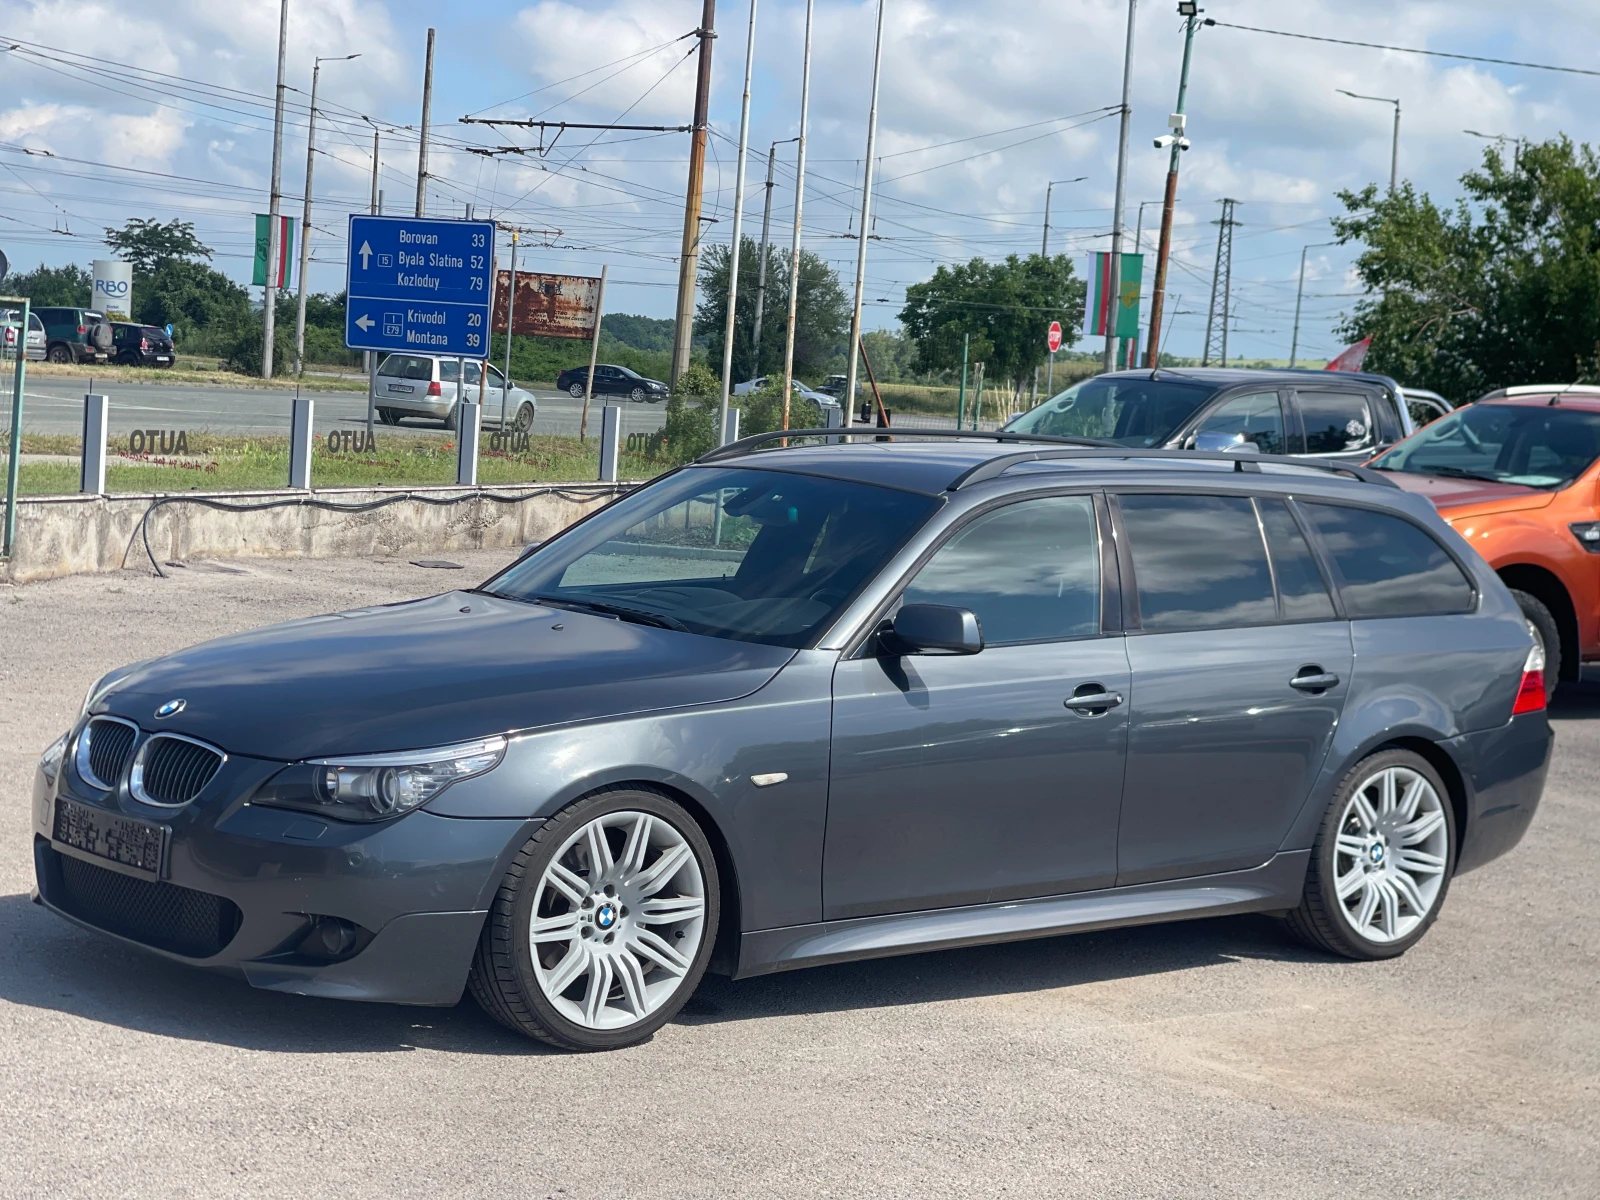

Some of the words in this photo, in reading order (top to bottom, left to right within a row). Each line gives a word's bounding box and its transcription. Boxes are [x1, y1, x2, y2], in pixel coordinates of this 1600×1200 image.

[399, 229, 438, 245] Borovan
[471, 233, 485, 248] 33
[381, 256, 389, 265] 15
[398, 251, 425, 268] Byala
[429, 253, 463, 268] Slatina
[470, 255, 484, 269] 52
[95, 279, 128, 298] RBO
[397, 272, 440, 291] Kozloduy
[469, 276, 483, 291] 79
[407, 309, 446, 325] Krivodol
[467, 313, 481, 327] 20
[386, 325, 400, 335] E79
[406, 329, 448, 345] Montana
[466, 333, 480, 347] 39
